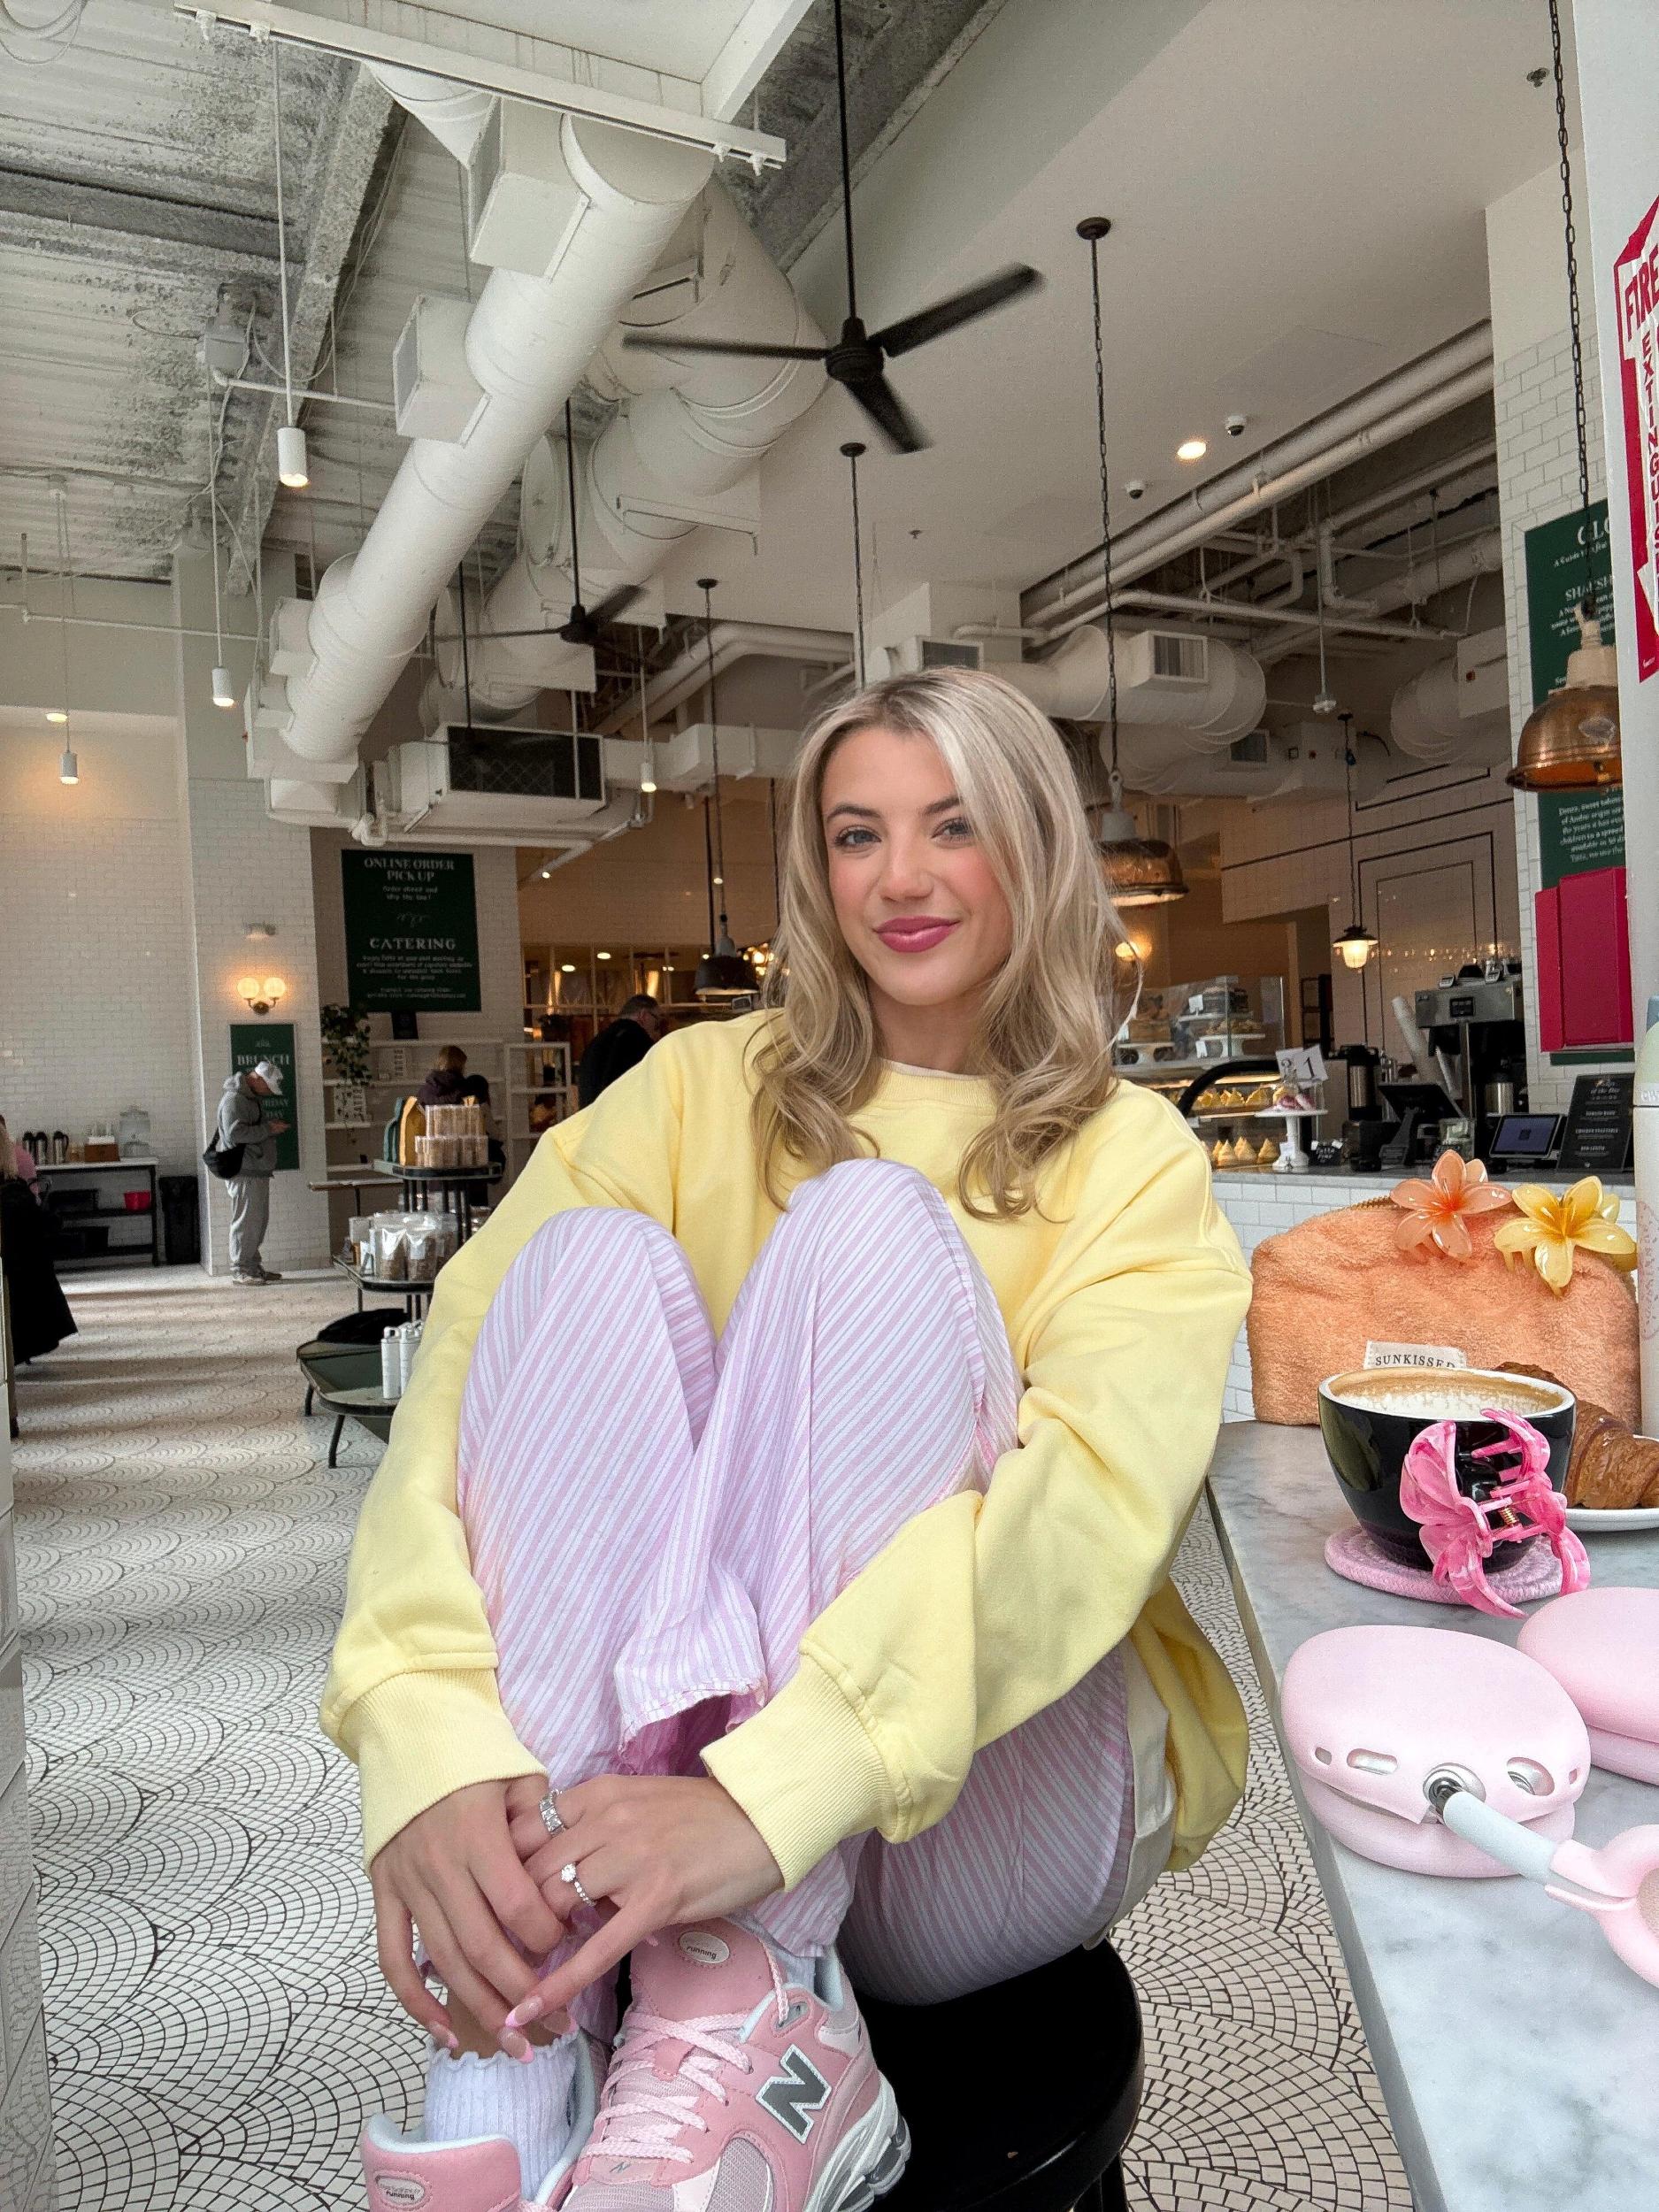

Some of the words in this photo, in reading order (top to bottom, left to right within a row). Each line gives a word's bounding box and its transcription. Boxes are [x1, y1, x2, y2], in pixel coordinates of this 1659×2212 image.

[1624, 243, 1659, 342] FIRE
[364, 856, 411, 869] ONLINE
[412, 857, 455, 871] ORDER
[387, 870, 415, 882] PICK
[417, 871, 434, 883] UP
[369, 938, 457, 950] CATERING
[687, 1947, 717, 1960] running
[757, 2044, 832, 2144] N
[386, 2190, 415, 2200] running
